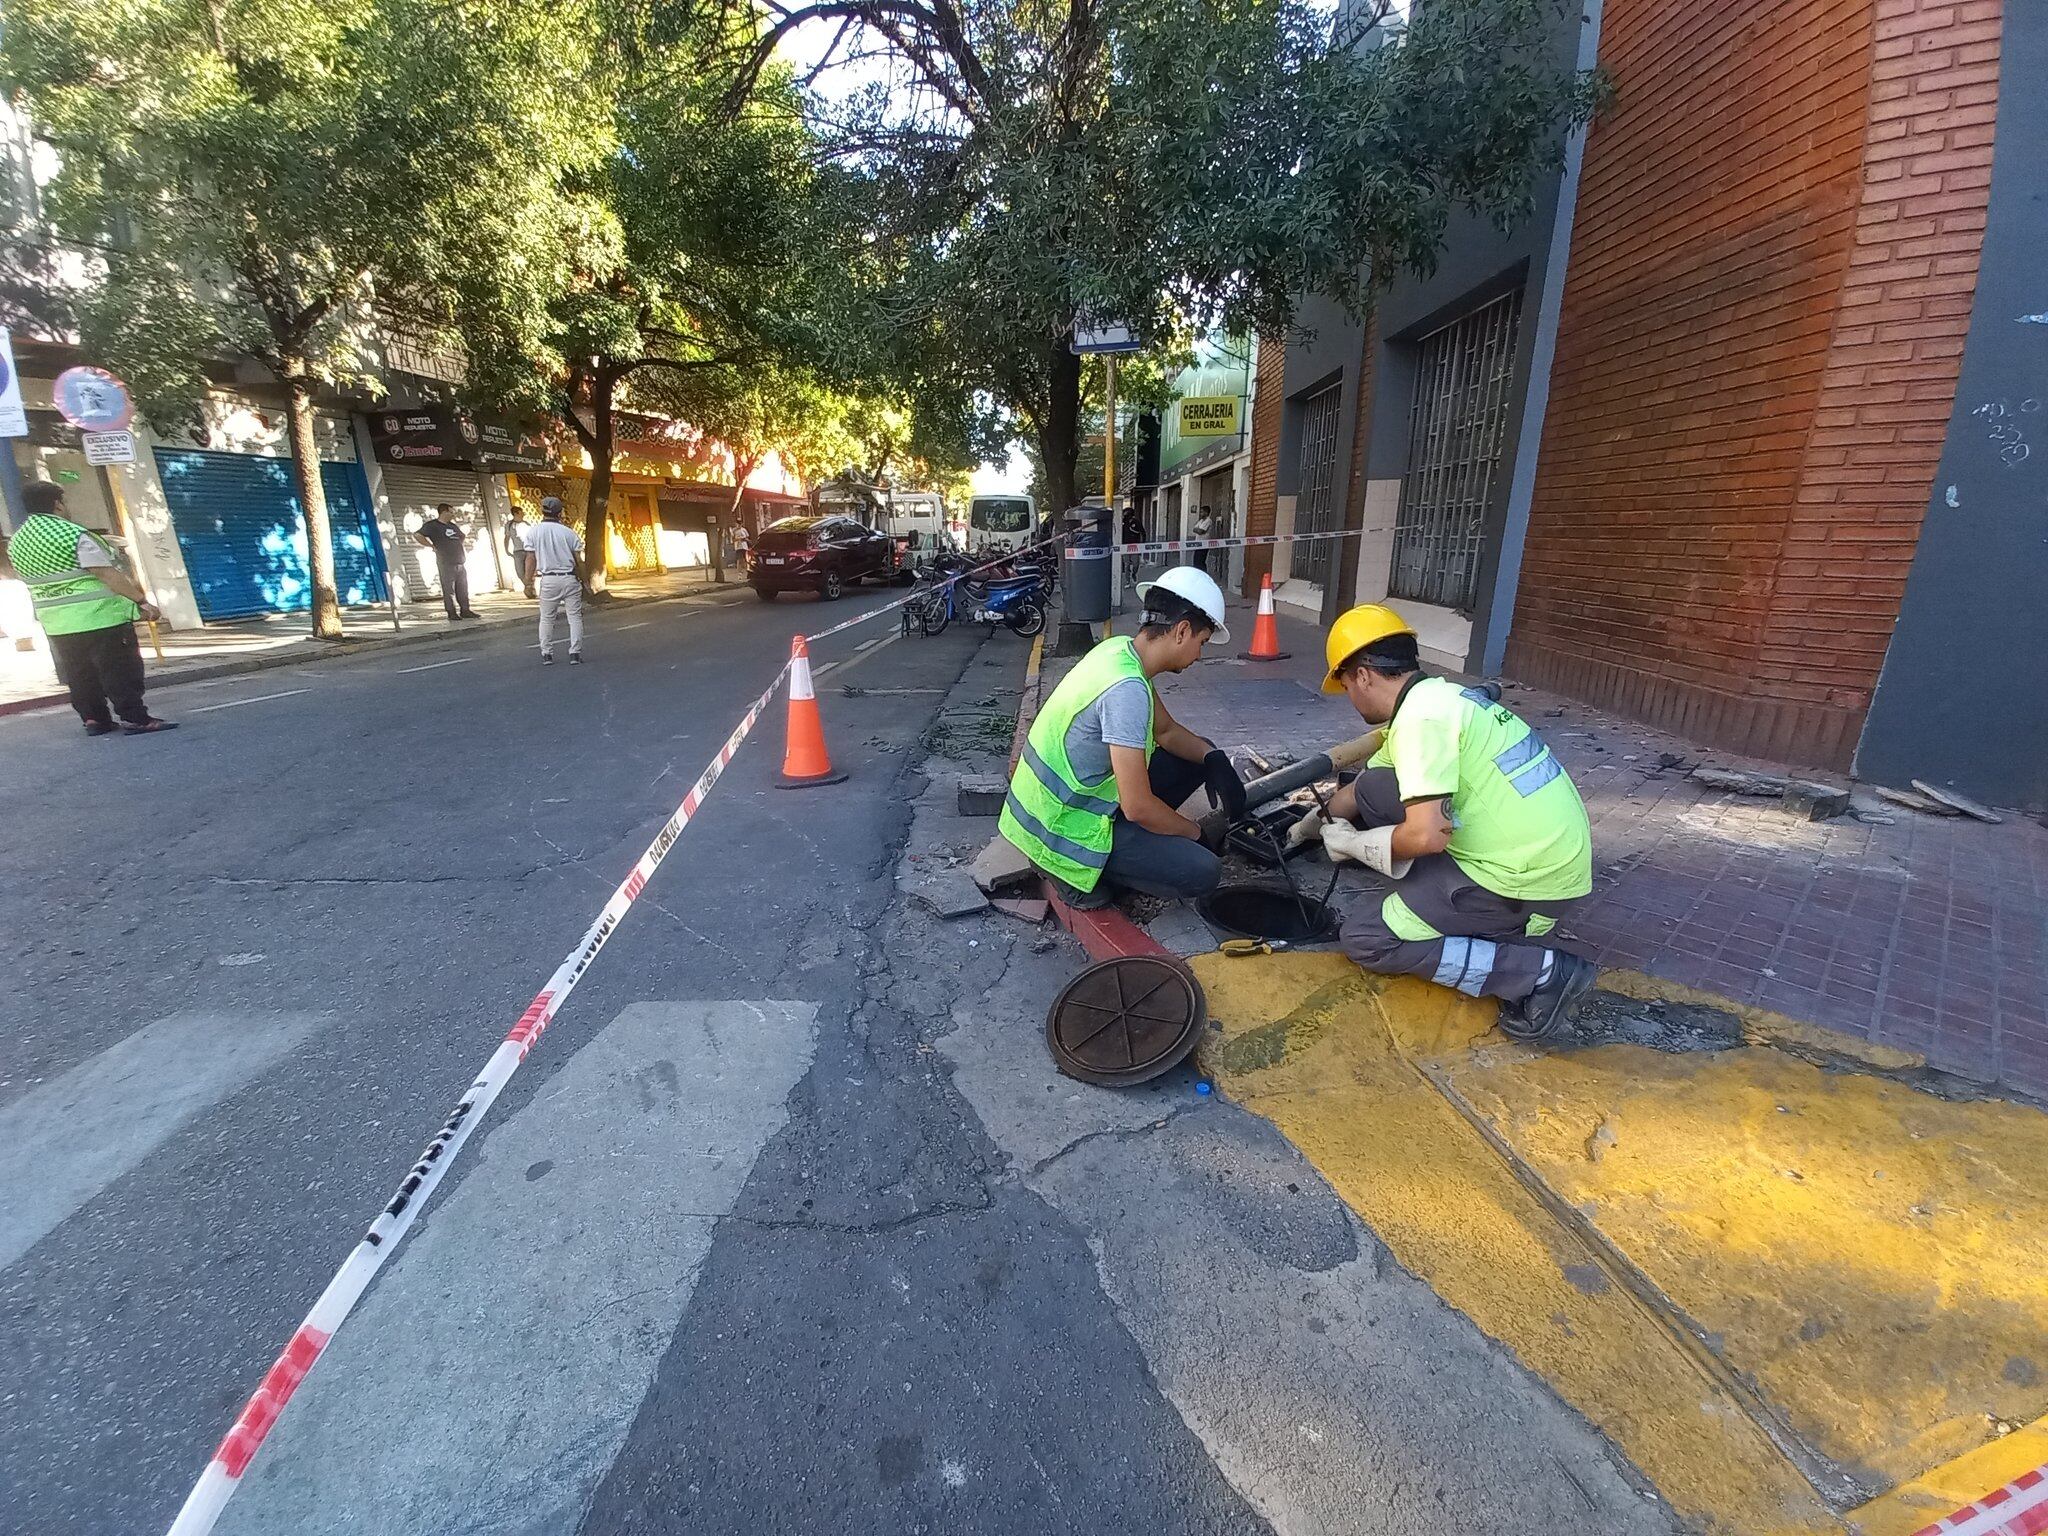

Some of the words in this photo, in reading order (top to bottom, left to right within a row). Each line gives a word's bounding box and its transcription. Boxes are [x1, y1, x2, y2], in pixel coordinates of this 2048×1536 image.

[1183, 403, 1234, 419] CERRAJERIA
[385, 419, 400, 431] CD
[407, 416, 431, 424] MOTO
[1189, 420, 1201, 429] EN
[1203, 420, 1226, 429] GRAL
[462, 422, 477, 439] CD
[484, 425, 508, 437] MOTO
